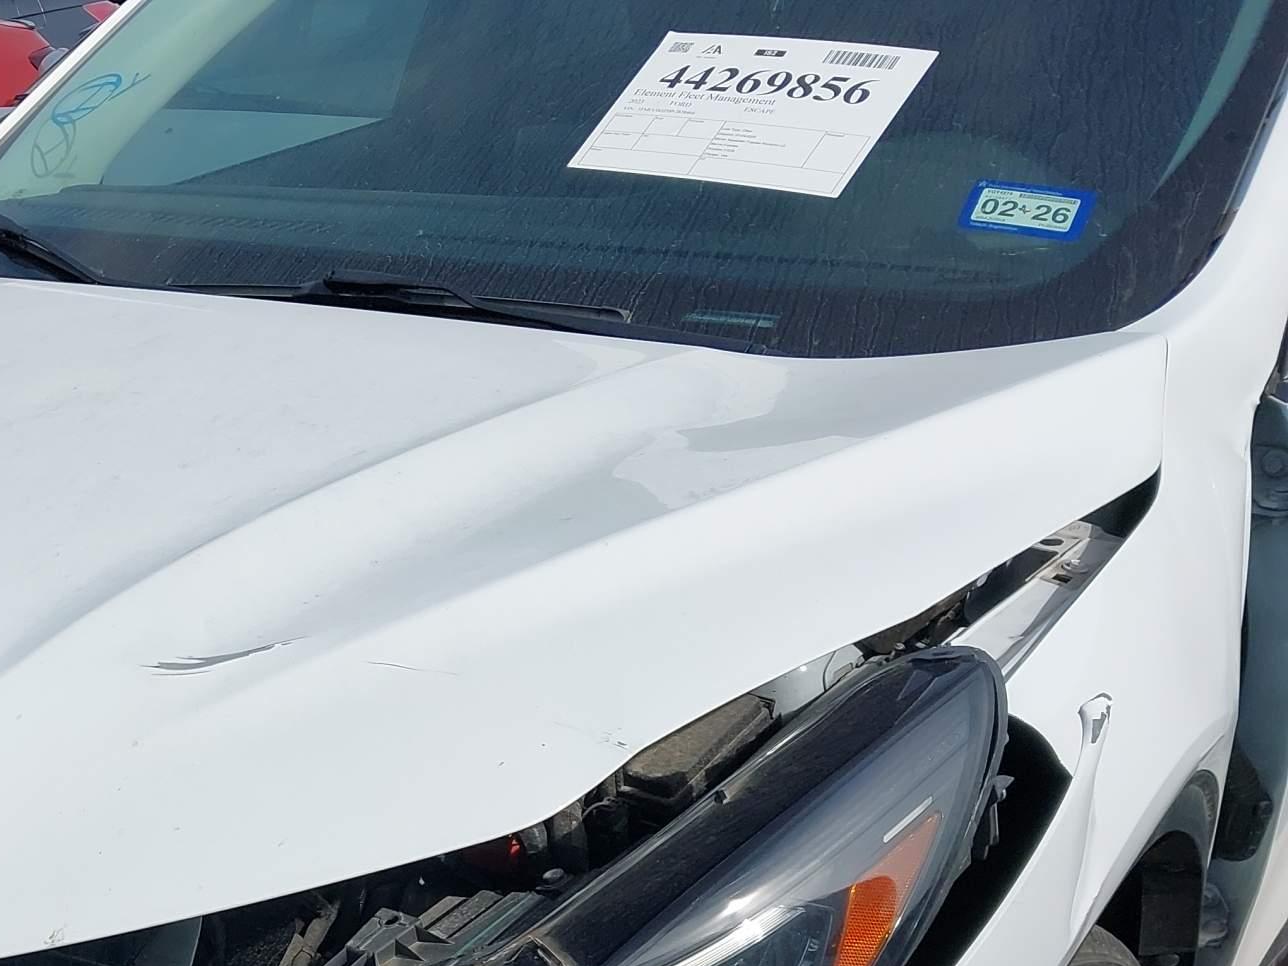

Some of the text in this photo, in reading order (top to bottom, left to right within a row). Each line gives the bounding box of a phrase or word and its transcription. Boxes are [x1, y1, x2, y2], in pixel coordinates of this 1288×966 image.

[633, 88, 776, 106] Element Fleet Management
[659, 64, 880, 105] 44269856
[980, 198, 1072, 224] 02 26
